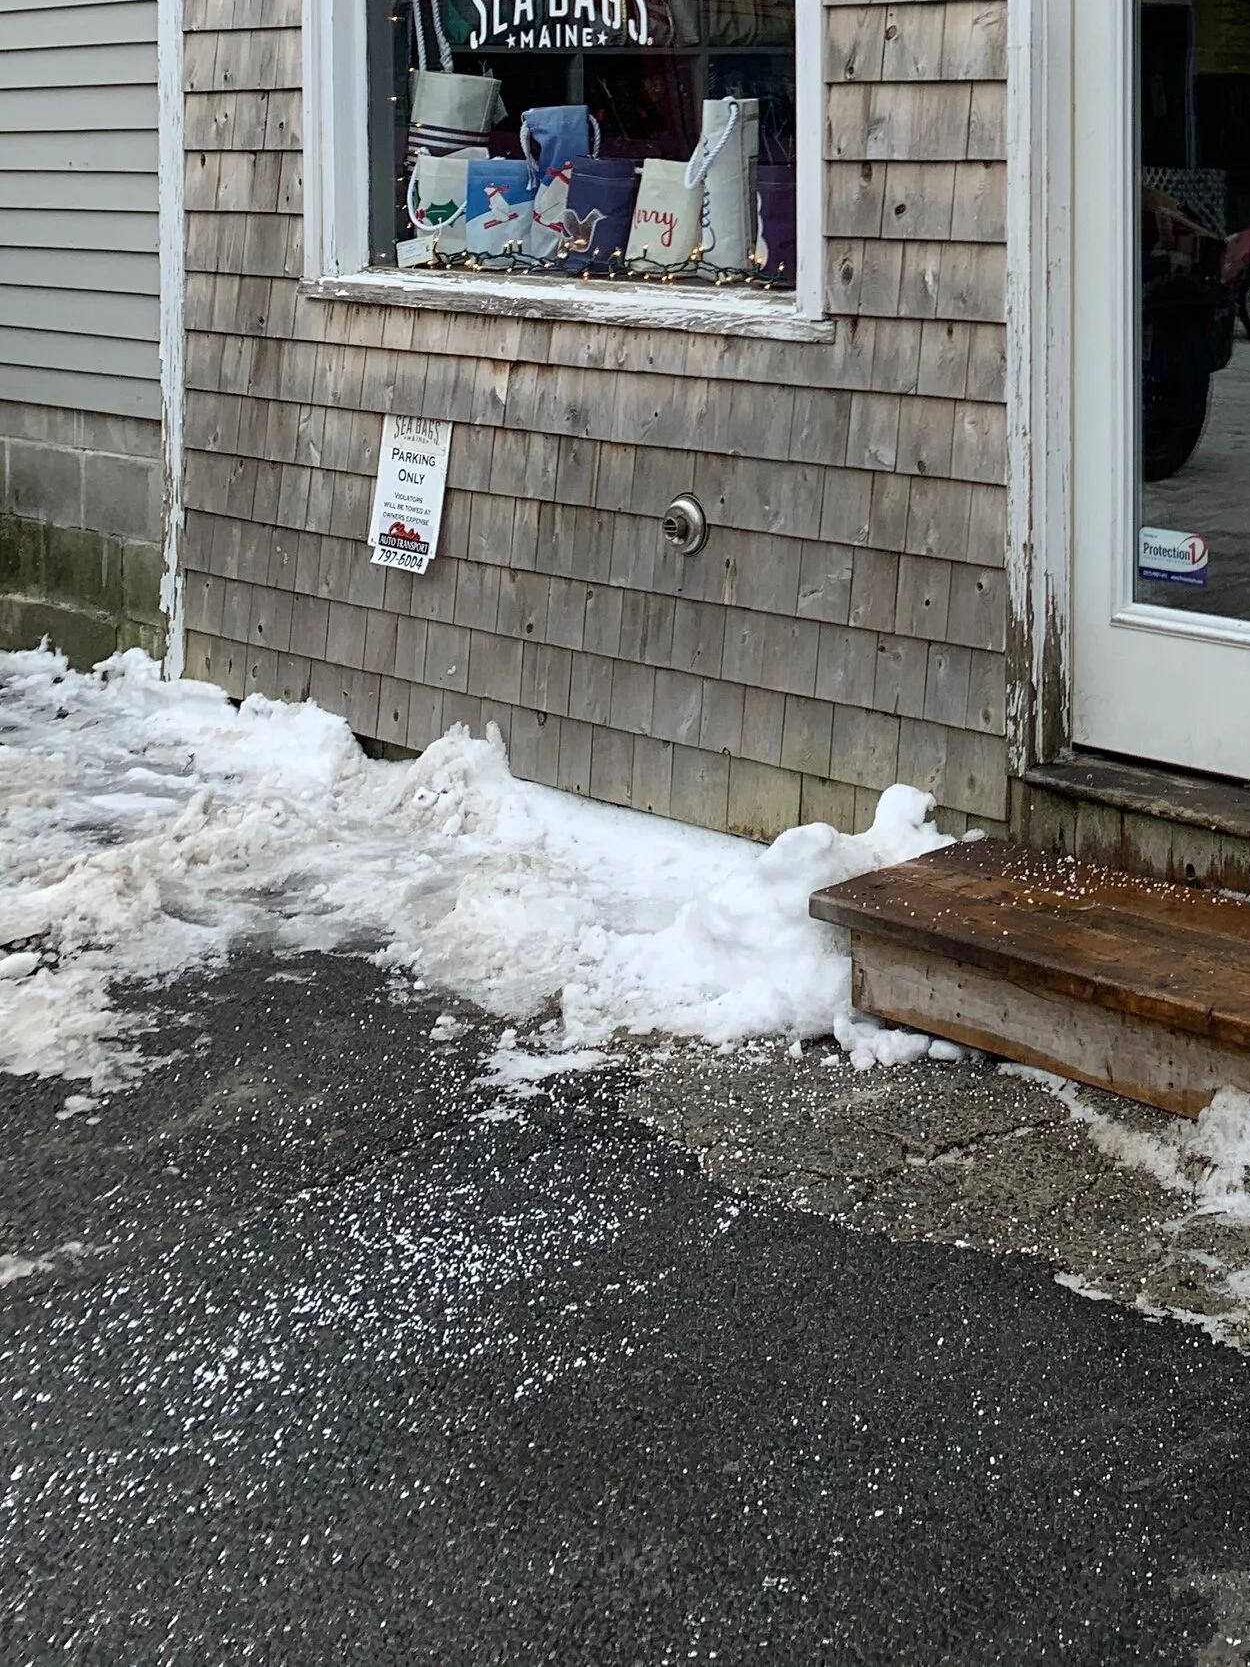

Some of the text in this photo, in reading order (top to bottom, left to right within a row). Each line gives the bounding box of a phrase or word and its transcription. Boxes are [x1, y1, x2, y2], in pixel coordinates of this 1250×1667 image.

[520, 24, 594, 49] MAINE
[394, 415, 441, 445] SEA BAGS
[391, 447, 436, 466] PARKING
[398, 469, 425, 485] ONLY
[395, 492, 423, 503] VIOLATORS
[383, 502, 396, 510] WILL
[405, 505, 423, 514] TOWED
[380, 535, 428, 553] AUTO TRANSPORT
[1143, 542, 1190, 561] Protection
[378, 548, 424, 570] 797-6004
